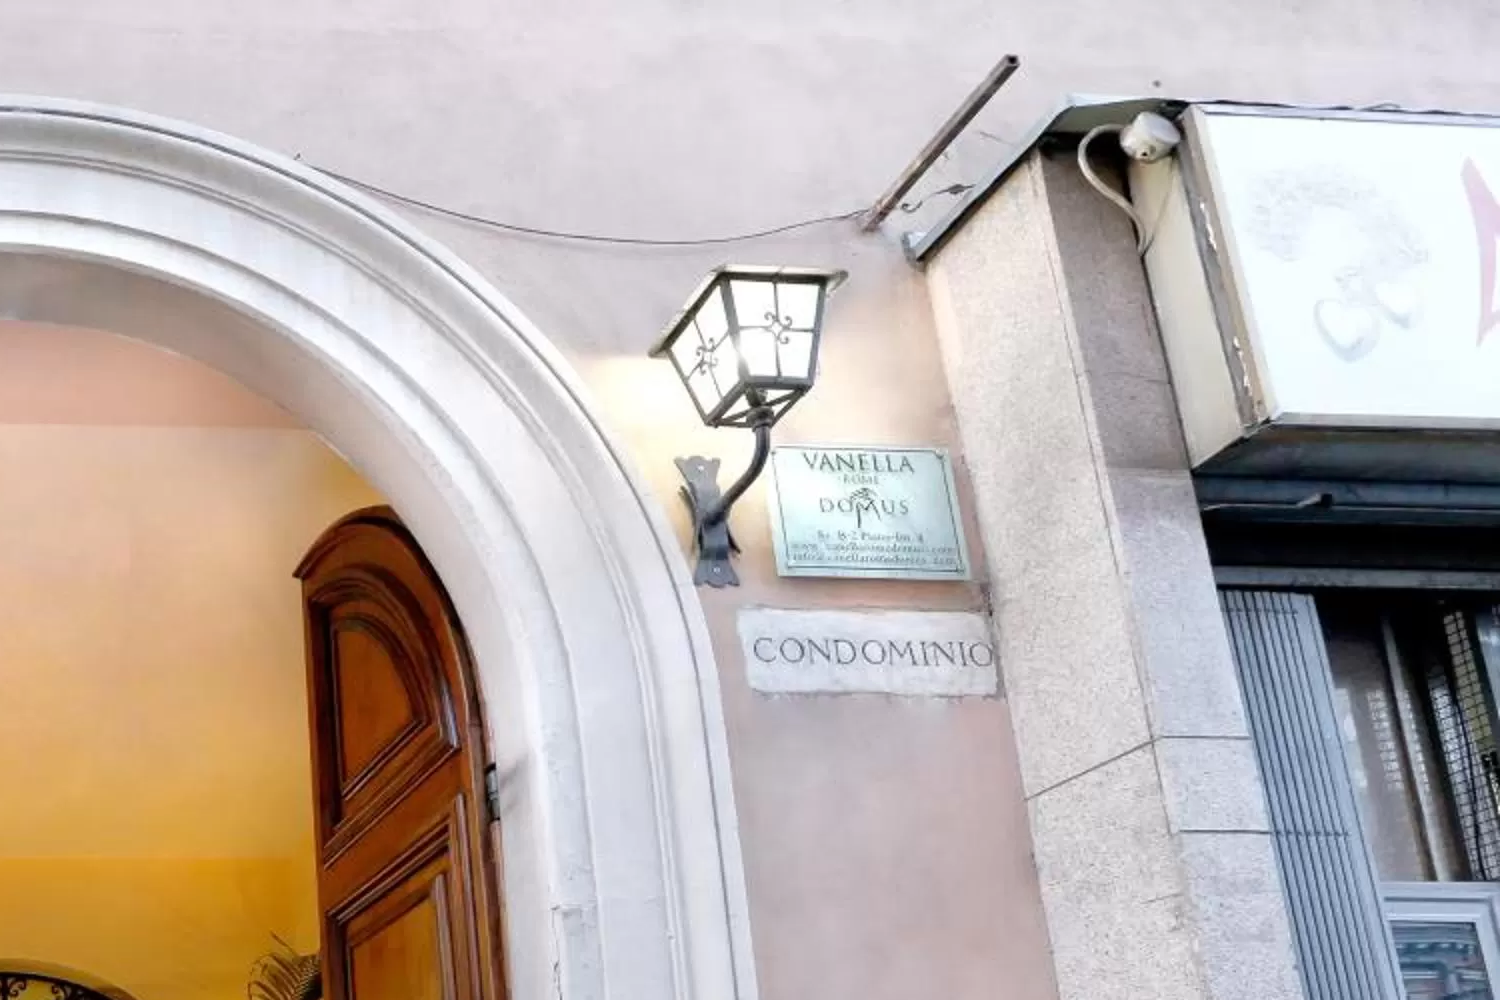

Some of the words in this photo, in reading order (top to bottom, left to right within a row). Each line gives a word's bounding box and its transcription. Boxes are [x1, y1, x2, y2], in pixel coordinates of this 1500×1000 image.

[801, 452, 915, 474] VANELLA
[819, 497, 909, 524] DOMUS
[752, 636, 994, 667] CONDOMINIO
